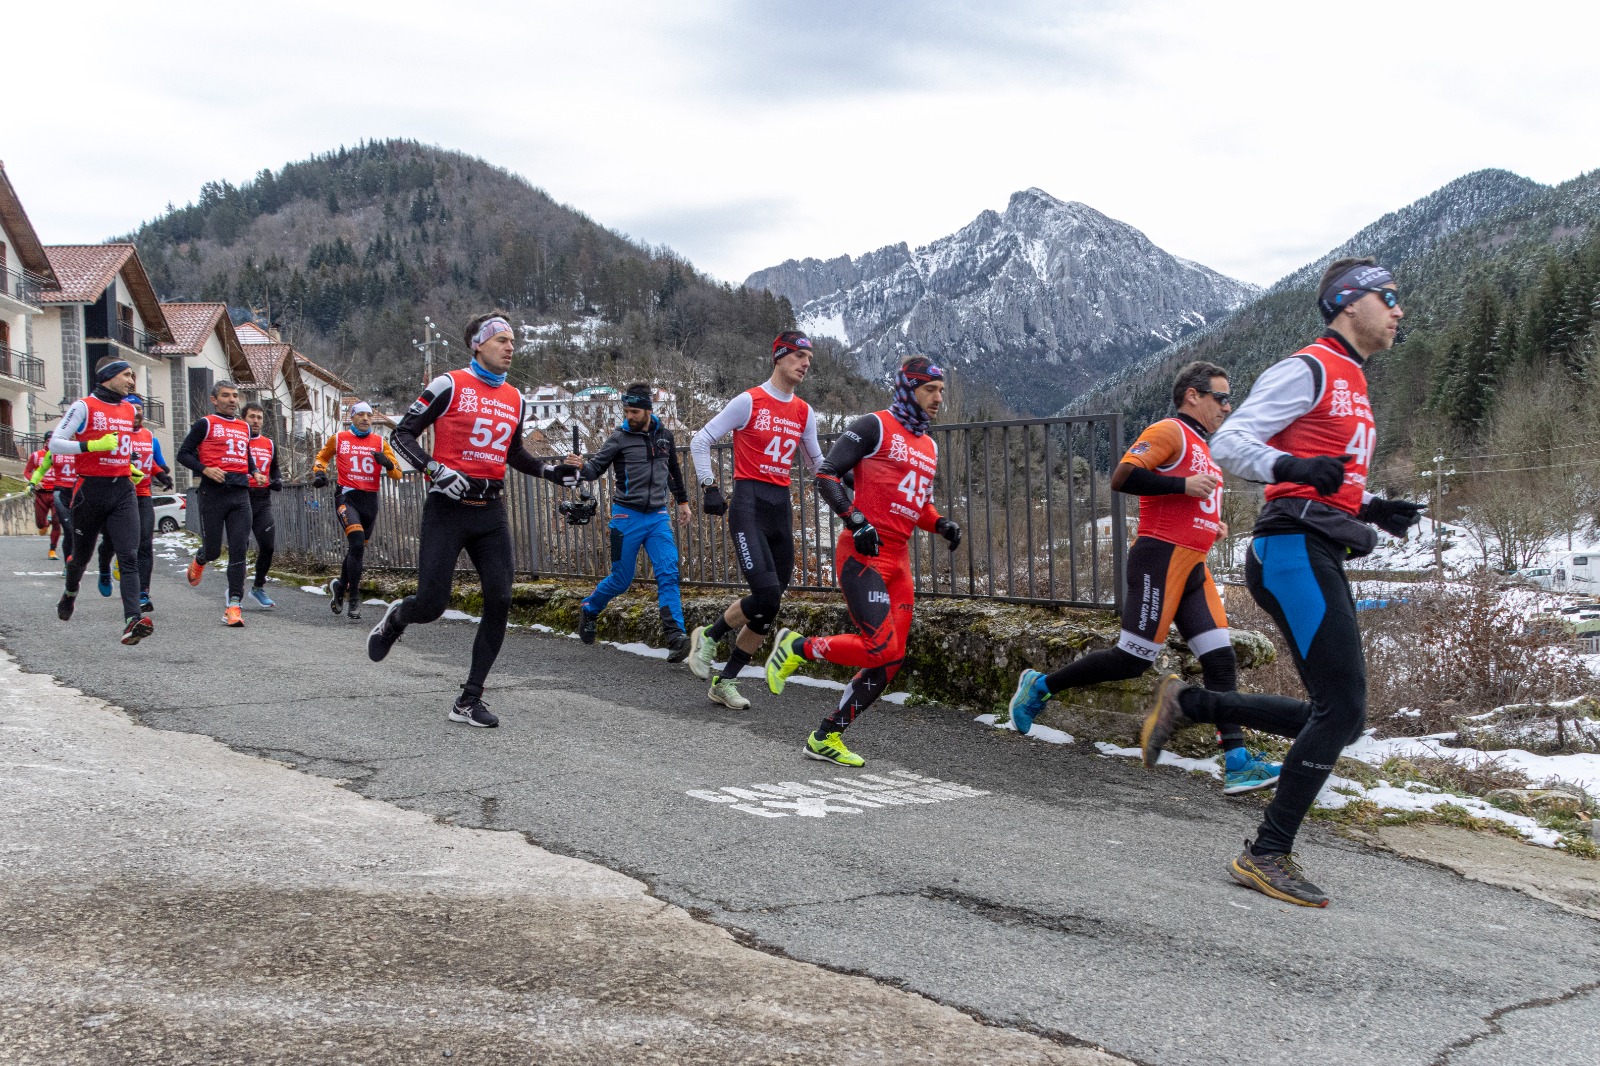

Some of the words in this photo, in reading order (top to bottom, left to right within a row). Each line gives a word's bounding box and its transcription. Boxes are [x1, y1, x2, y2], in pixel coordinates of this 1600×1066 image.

[480, 397, 515, 413] Gobierno
[481, 407, 492, 415] de
[469, 417, 512, 451] 52
[772, 425, 782, 433] de
[773, 416, 802, 429] Gobierno
[225, 439, 247, 457] 19
[764, 435, 797, 465] 42
[349, 456, 375, 474] 16
[897, 469, 931, 509] 45
[737, 532, 753, 570] AGOIZKO
[1150, 587, 1160, 622] TRIATLON
[685, 769, 943, 803] CAMILLE
[729, 781, 991, 818] EXTREME
